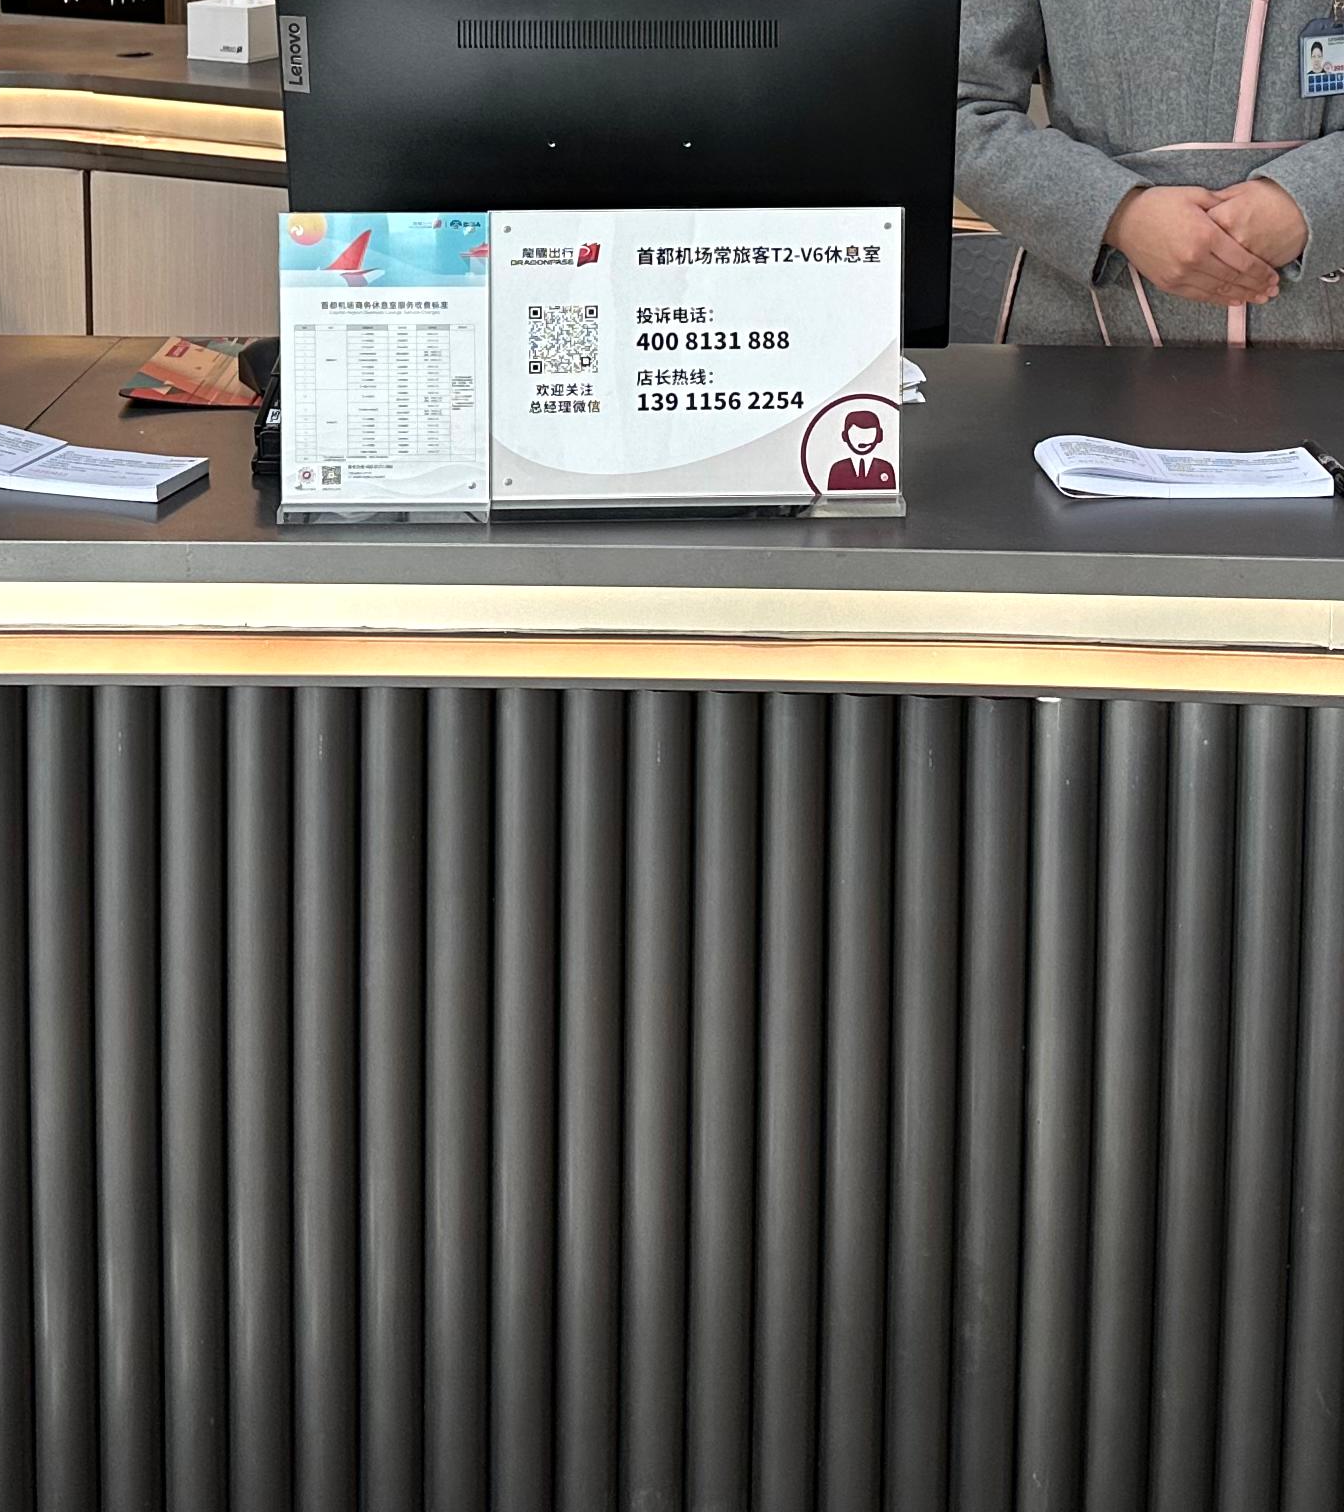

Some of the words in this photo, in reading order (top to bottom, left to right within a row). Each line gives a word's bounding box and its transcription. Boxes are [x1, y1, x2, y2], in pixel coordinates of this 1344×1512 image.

[289, 23, 303, 86] Lenovo
[637, 245, 881, 267] 首都机场常旅客T2-V6休息室
[637, 307, 715, 325] 投诉电话：
[637, 333, 679, 351] 400
[685, 332, 741, 350] 8131
[748, 331, 790, 350] 888
[637, 369, 715, 386] 店长热线：
[536, 383, 593, 397] 欢迎关注
[529, 400, 601, 414] 总经理微信
[637, 393, 679, 411] 139
[685, 392, 741, 410] 1156
[748, 391, 804, 410] 2254
